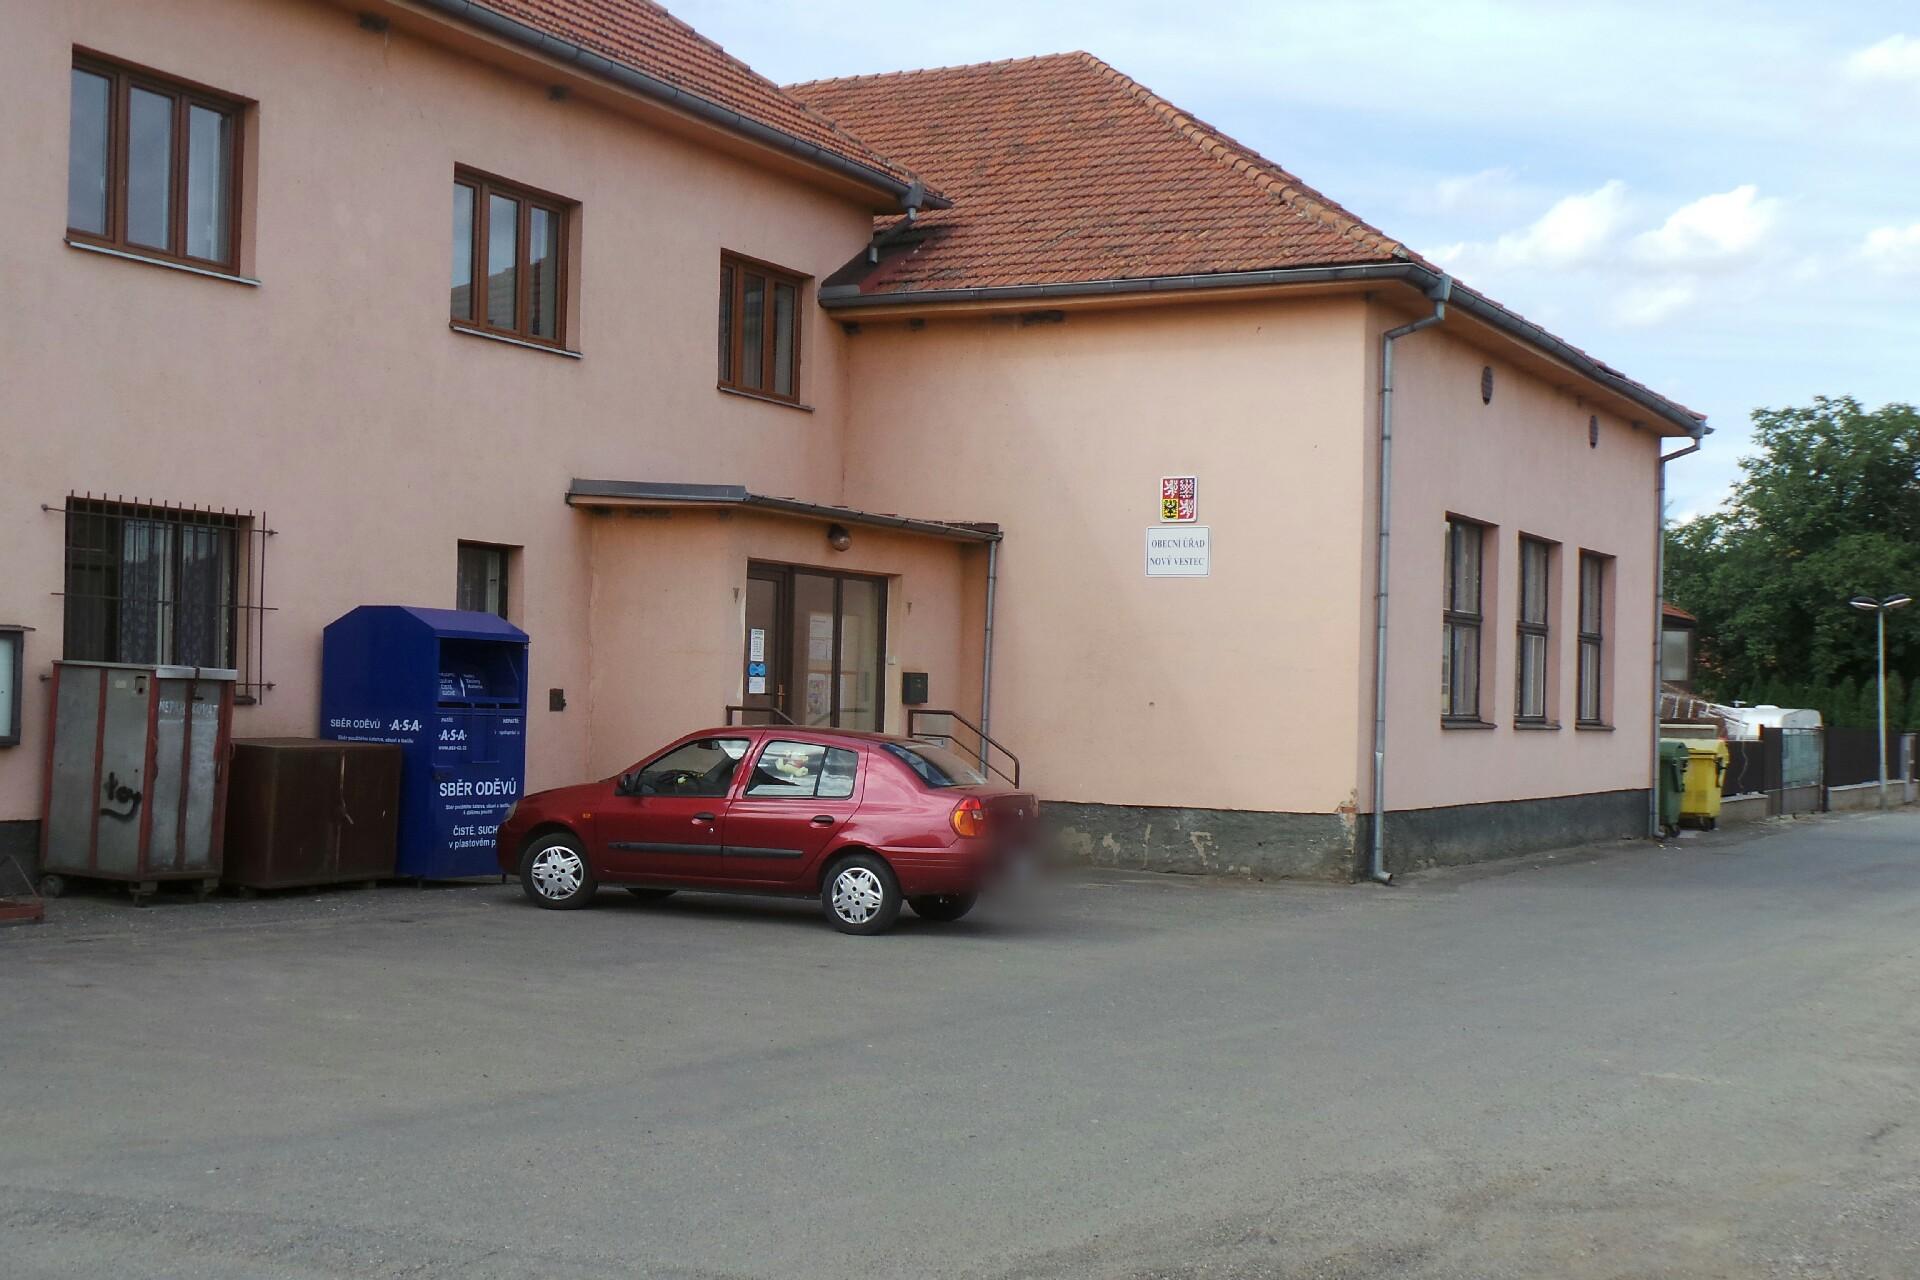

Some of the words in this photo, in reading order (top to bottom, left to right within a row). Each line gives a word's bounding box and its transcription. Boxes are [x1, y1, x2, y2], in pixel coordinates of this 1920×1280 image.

[1183, 536, 1205, 548] ÚŘAD
[1150, 555, 1171, 566] NOVÝ
[1173, 557, 1205, 566] VESTEC
[330, 717, 352, 728] SBĚR
[439, 779, 473, 797] SBĚR
[475, 777, 517, 796] ODĚVŮ
[477, 825, 498, 835] SUCH
[449, 841, 454, 849] v
[454, 838, 490, 850] plastovém
